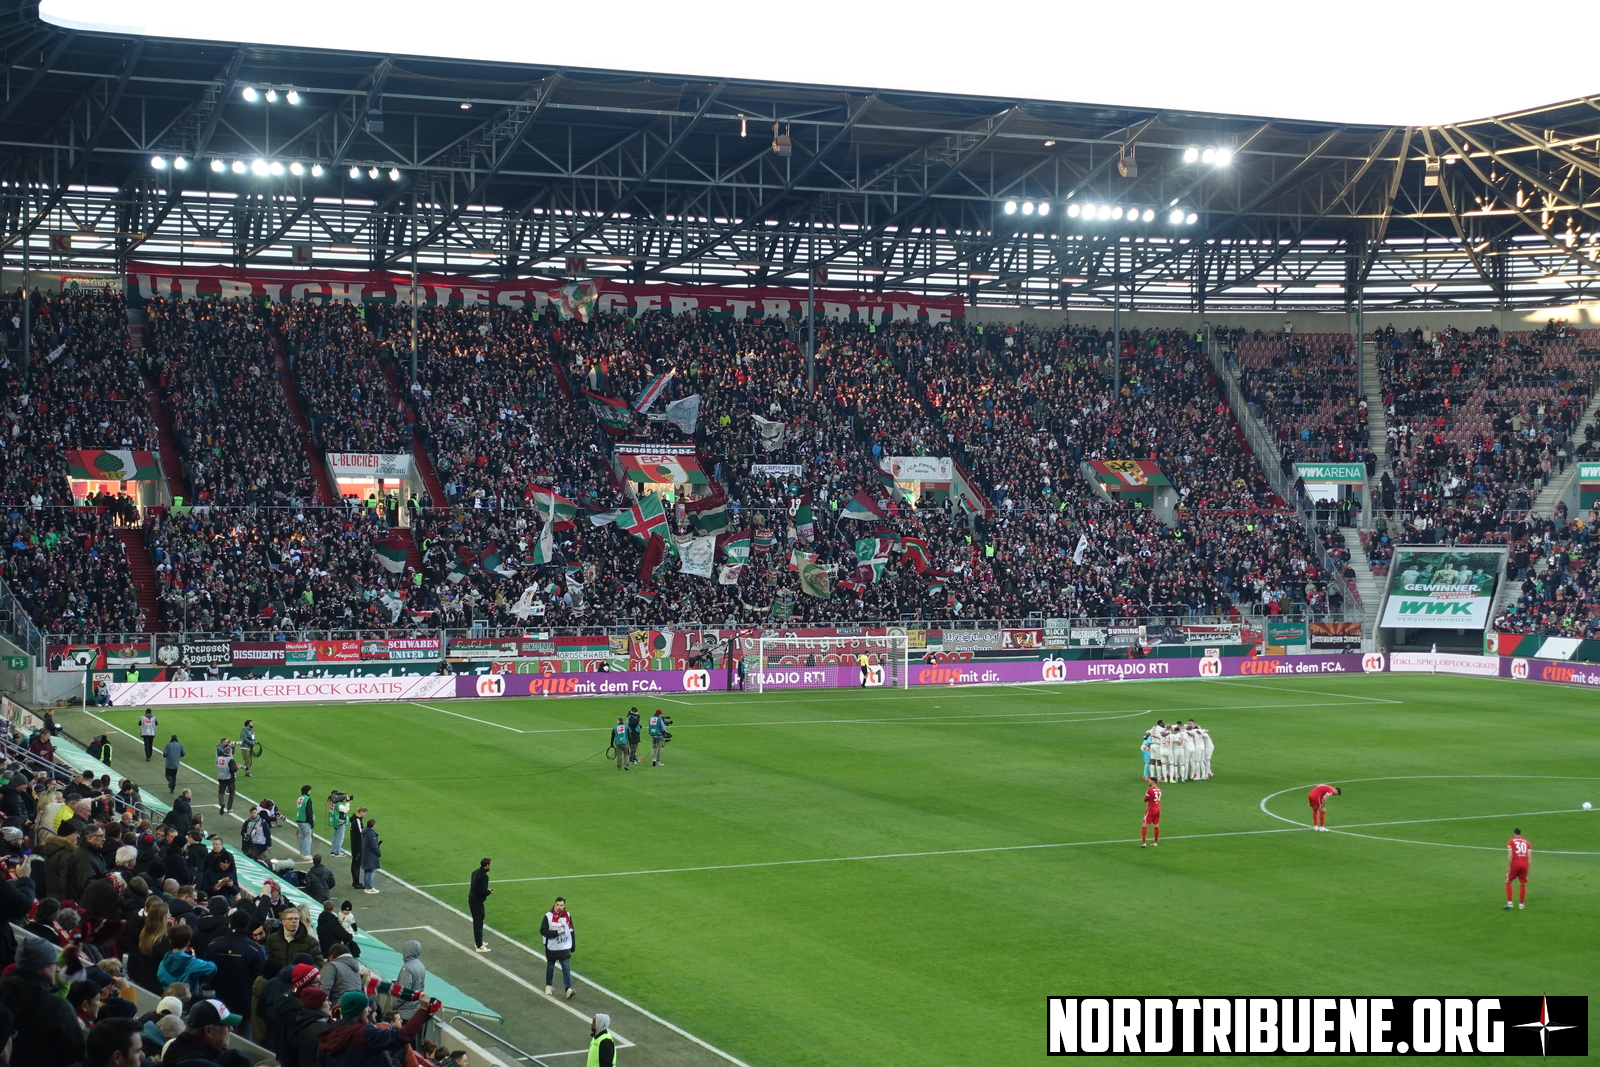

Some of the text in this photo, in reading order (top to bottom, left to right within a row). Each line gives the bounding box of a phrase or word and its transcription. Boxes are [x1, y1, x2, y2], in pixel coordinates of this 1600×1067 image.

[51, 235, 69, 252] K
[297, 246, 308, 261] L
[566, 257, 586, 273] M
[813, 268, 827, 283] N
[619, 447, 691, 455] FUGGERSTADT
[332, 454, 379, 468] L-BLOCKER
[640, 455, 674, 464] FCA
[1404, 583, 1481, 592] GEWINNER.
[1398, 600, 1474, 616] WWK
[342, 642, 359, 650] Bella
[388, 639, 439, 649] SCHWABEN
[232, 649, 285, 660] DISSIDENTS
[389, 649, 439, 659] UNITED 07
[556, 651, 613, 659] NORDSCHWABEN
[1087, 662, 1169, 676] HITRADIO RT1
[1202, 660, 1219, 674] rt1
[1240, 655, 1345, 675] eins mit dem FCA.
[1364, 656, 1382, 670] rt1
[1472, 662, 1498, 671] GRATIS
[1513, 663, 1526, 677] rt1
[918, 664, 1000, 684] eins mit dir.
[1045, 666, 1063, 680] rt1
[1542, 662, 1576, 683] eins
[1571, 674, 1586, 684] mit
[480, 677, 502, 694] rt1
[528, 672, 663, 695] eins mit dem FCA.
[686, 672, 707, 689] rt1
[217, 683, 344, 698] SPIELERFLOCK
[345, 681, 403, 696] GRATIS
[1514, 841, 1527, 854] 30
